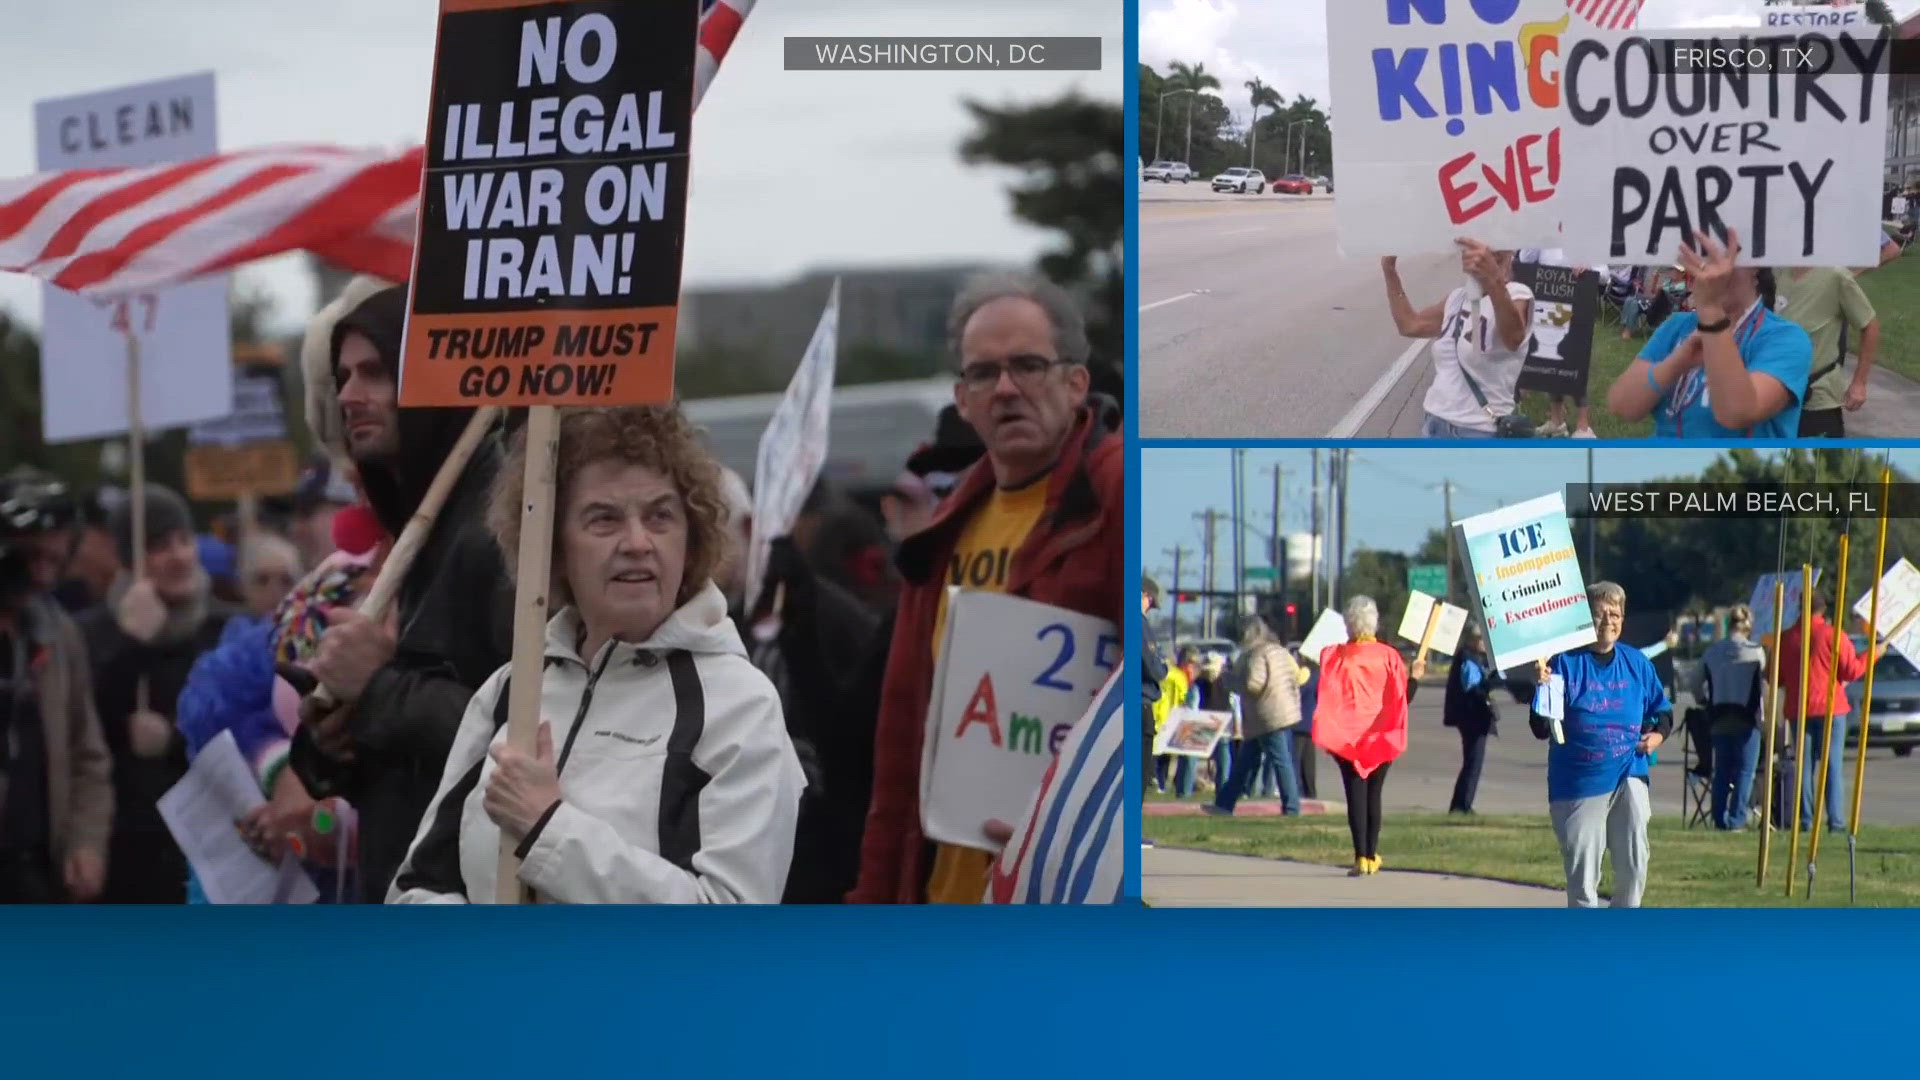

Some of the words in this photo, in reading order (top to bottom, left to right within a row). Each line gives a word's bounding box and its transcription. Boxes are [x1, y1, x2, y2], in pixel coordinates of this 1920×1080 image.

[517, 13, 617, 88] NO
[1564, 26, 1891, 126] COUNTRY
[60, 97, 195, 153] CLEAN
[443, 91, 676, 161] ILLEGAL
[1650, 121, 1781, 155] OVER
[443, 168, 565, 231] WAR
[584, 162, 668, 226] ON
[1610, 158, 1835, 258] PARTY
[463, 232, 636, 300] IRAN!
[1535, 268, 1577, 284] ROYAL
[1534, 282, 1575, 297] FLUSH
[427, 324, 545, 360] TRUMP
[553, 323, 659, 358] MUST
[459, 365, 510, 397] GO
[518, 363, 617, 397] NOW!
[1498, 522, 1546, 559] ICE
[1502, 573, 1562, 602] Criminal
[1505, 592, 1588, 626] Executioners
